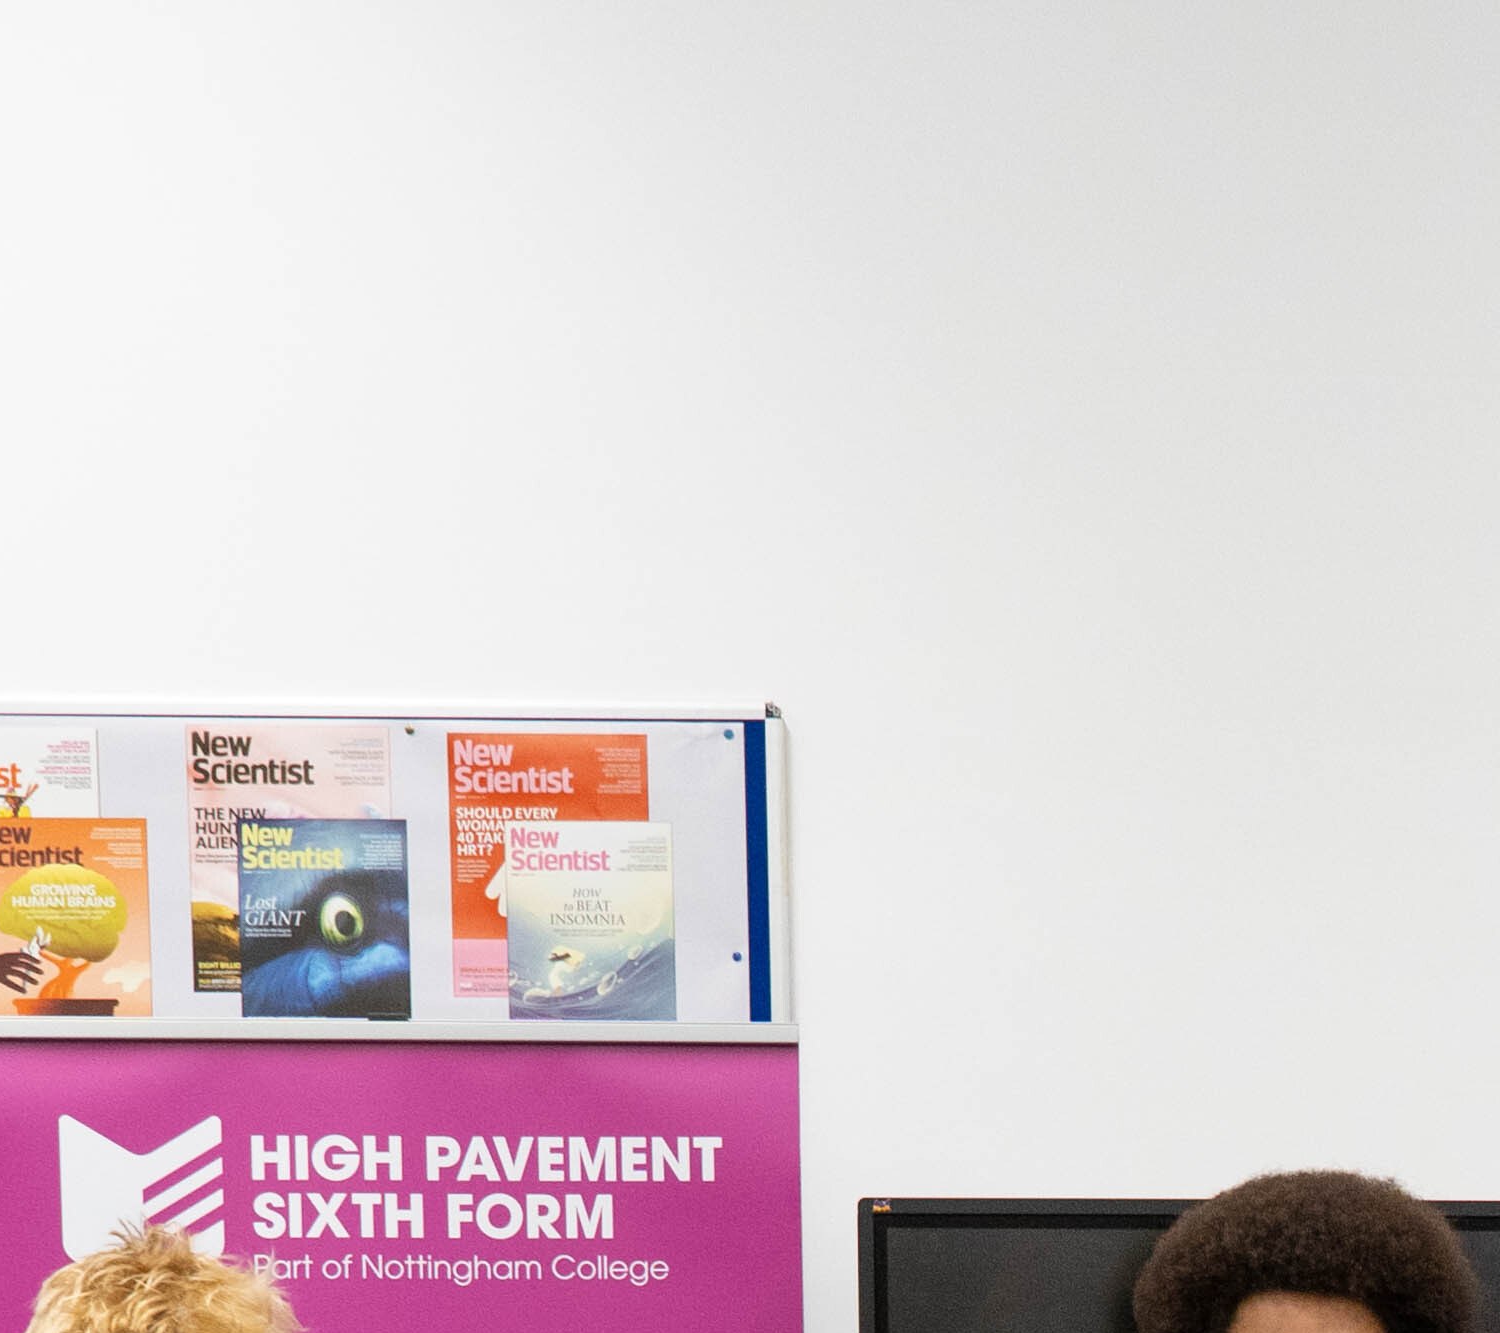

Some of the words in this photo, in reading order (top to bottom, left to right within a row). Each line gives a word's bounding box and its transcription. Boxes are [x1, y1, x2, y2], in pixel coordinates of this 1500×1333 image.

[192, 731, 252, 757] New
[453, 739, 514, 767] New
[193, 758, 315, 785] Scientist
[454, 766, 574, 793] Scientist
[194, 807, 227, 820] THE
[229, 808, 266, 820] NEW
[456, 807, 513, 820] SHOULD
[515, 807, 558, 820] EVERY
[241, 823, 293, 846] New
[456, 820, 505, 832] WOMA
[456, 832, 474, 844] 40
[510, 828, 560, 849] New
[242, 846, 346, 870] Scientist
[456, 844, 494, 857] HRT?
[511, 850, 611, 871] Scientist
[31, 884, 96, 897] GROWING
[572, 888, 603, 898] HOW
[12, 896, 66, 908] HUMAN
[68, 896, 117, 908] BRAINS
[245, 894, 277, 910] Lost
[563, 903, 573, 912] to
[576, 900, 612, 912] BEAT
[245, 910, 307, 927] GIANT
[550, 914, 626, 926] INSOMNIA
[250, 1135, 403, 1182] HIGH
[425, 1136, 723, 1182] PAVEMENT
[252, 1192, 423, 1240] SIXTH
[447, 1192, 614, 1240] FORM
[254, 1253, 313, 1281] Part
[324, 1253, 353, 1281] of
[360, 1253, 543, 1287] Nottingham
[550, 1253, 670, 1287] College
